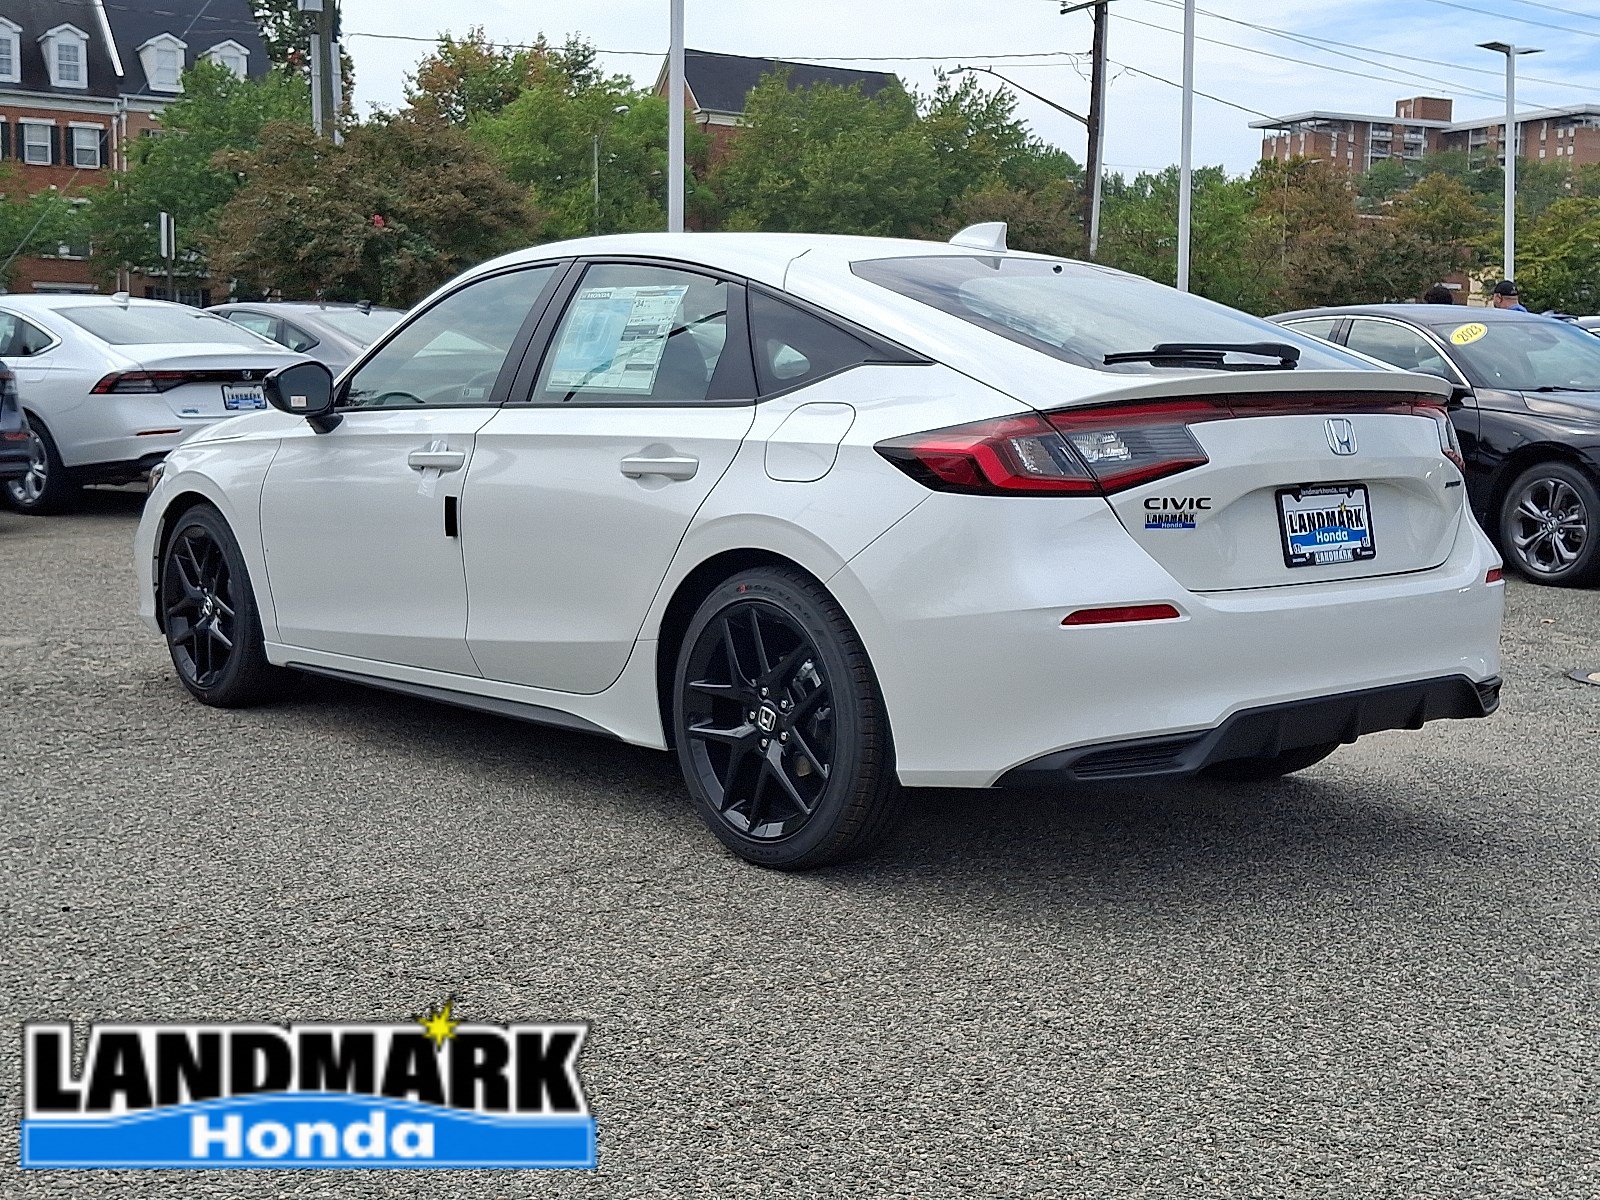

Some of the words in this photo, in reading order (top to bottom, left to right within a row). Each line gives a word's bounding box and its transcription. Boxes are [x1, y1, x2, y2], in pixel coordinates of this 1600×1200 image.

[1456, 324, 1483, 342] 2023
[1144, 497, 1212, 510] CIVIC
[1146, 512, 1195, 524] LANDMARK
[1161, 521, 1183, 529] Honda
[1289, 508, 1364, 534] LANDMARK
[1315, 529, 1348, 544] Honda
